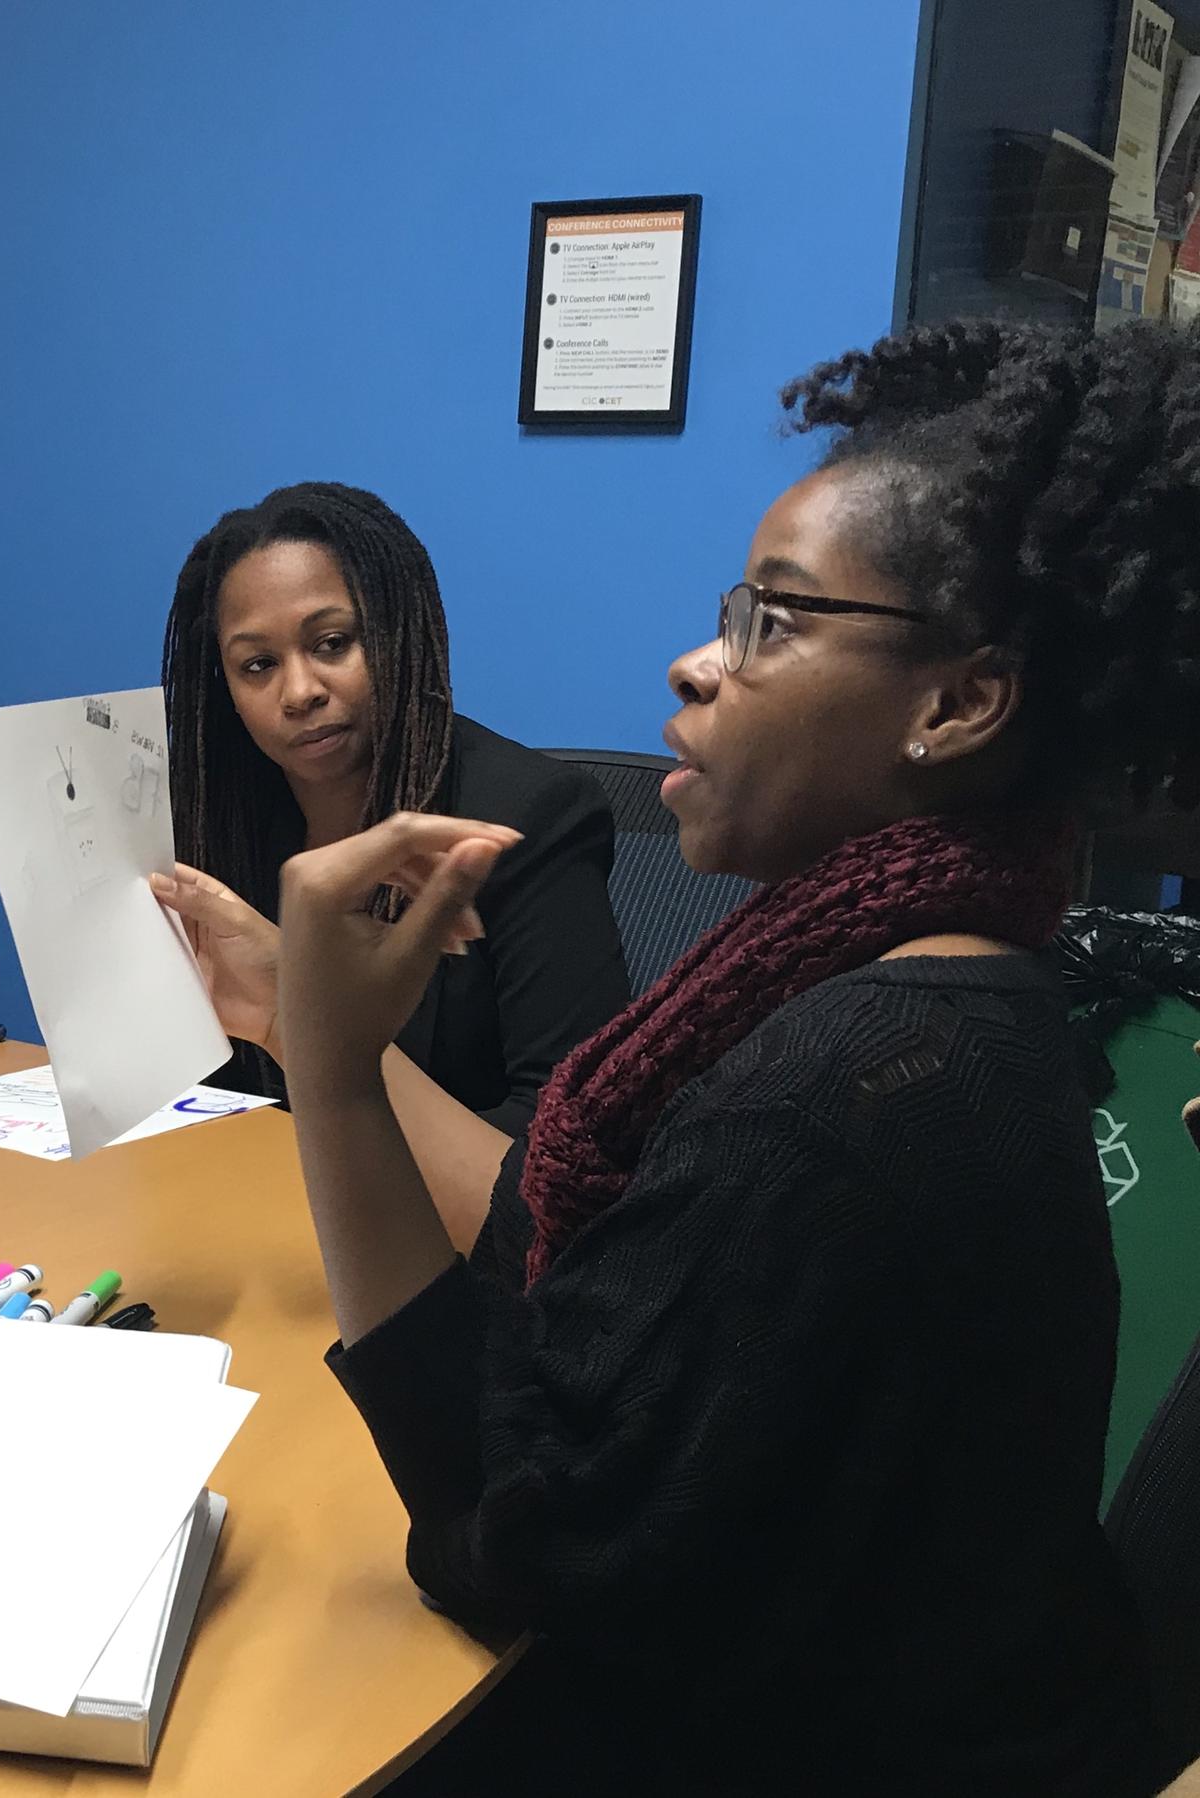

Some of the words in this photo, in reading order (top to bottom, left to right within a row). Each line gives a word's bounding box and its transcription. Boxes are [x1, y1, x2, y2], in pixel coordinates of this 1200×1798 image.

[547, 220, 611, 232] CONFERENCE
[612, 216, 683, 229] CONNECTIVITY
[563, 244, 572, 252] TV
[611, 242, 630, 251] Apple
[631, 241, 655, 251] AirPlay
[560, 295, 569, 303] TV
[608, 294, 626, 302] HDMI
[627, 292, 651, 302] (wired)
[556, 339, 592, 348] Conference
[593, 338, 608, 347] Calls
